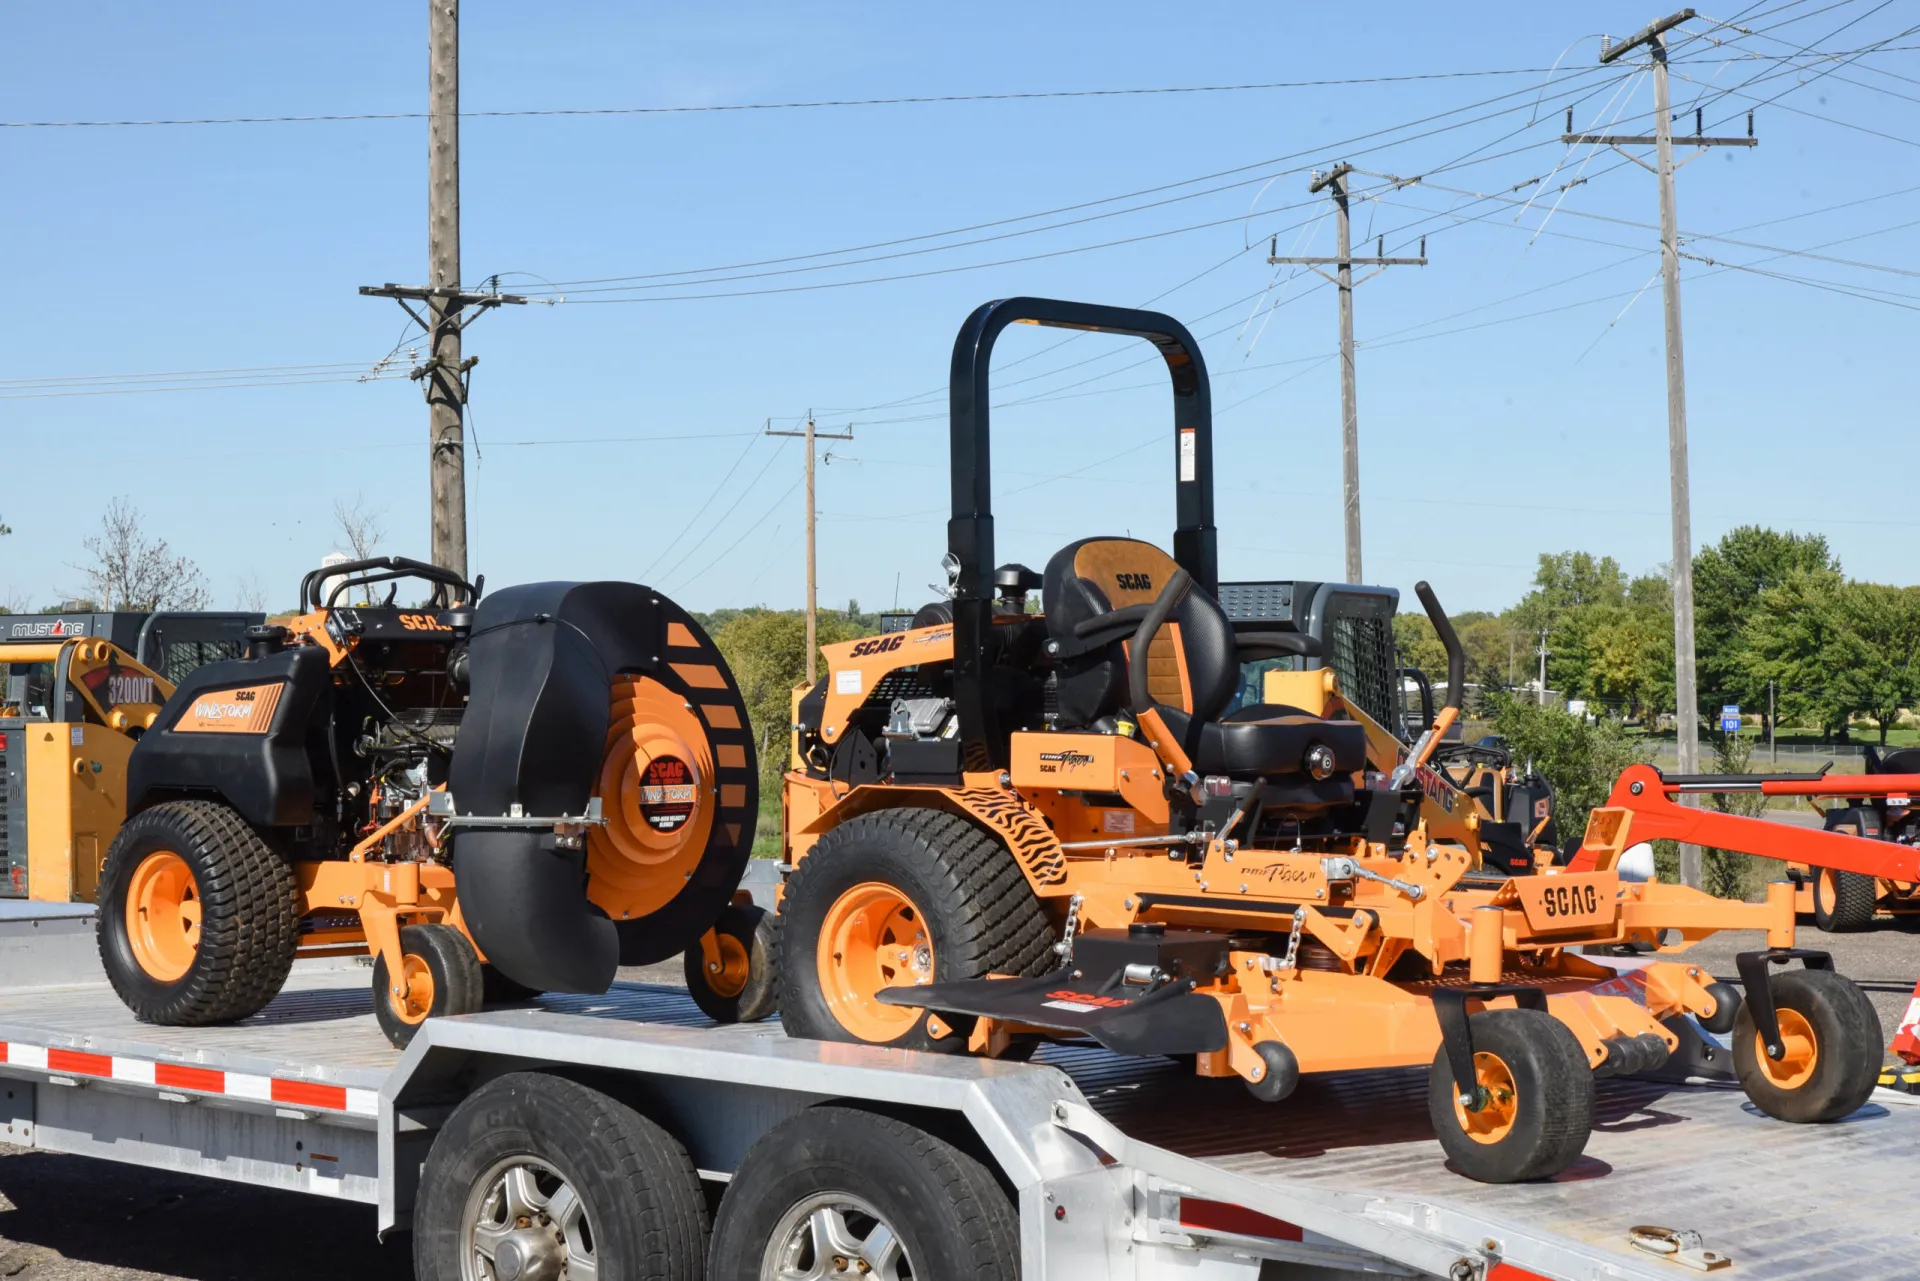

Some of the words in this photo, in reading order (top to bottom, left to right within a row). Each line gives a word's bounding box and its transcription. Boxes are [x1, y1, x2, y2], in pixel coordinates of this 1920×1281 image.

[1116, 573, 1152, 590] SCAG
[12, 620, 85, 637] MUSTANG
[399, 614, 453, 631] SCA
[849, 635, 905, 659] SCAG
[108, 676, 154, 705] 3200VT
[235, 691, 256, 701] SCAG
[649, 762, 684, 779] SCAG
[1544, 885, 1597, 917] SCAG
